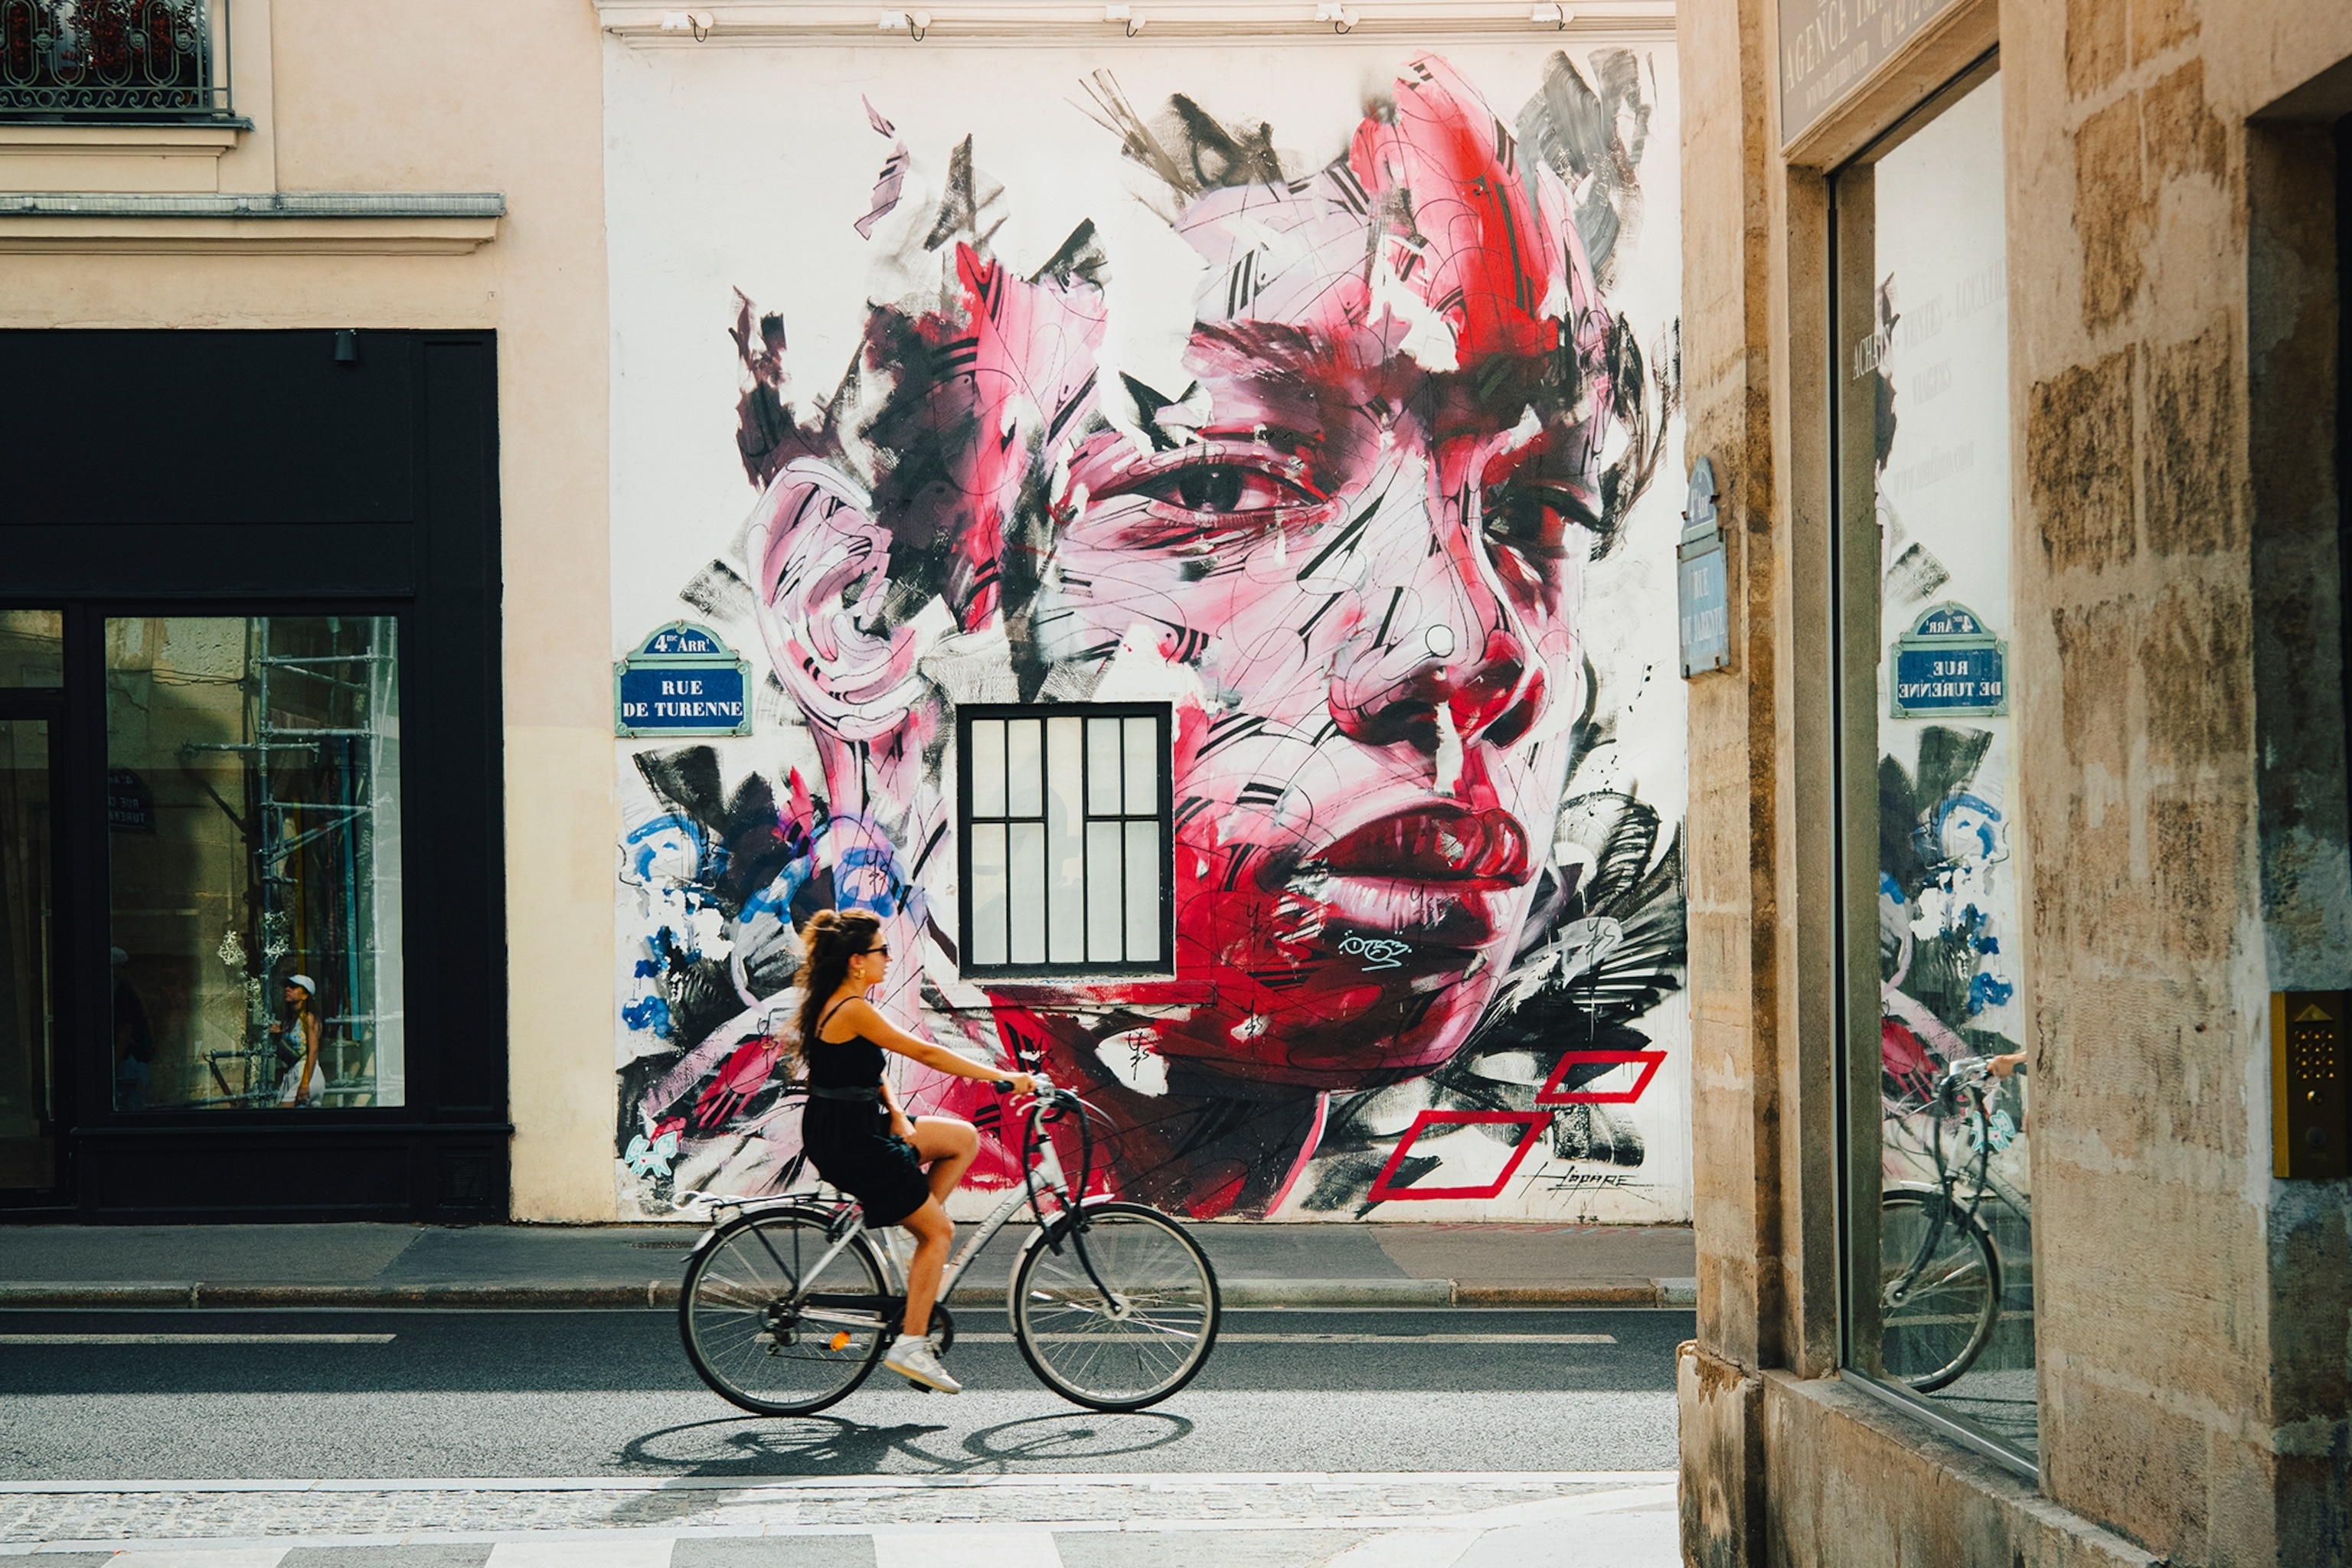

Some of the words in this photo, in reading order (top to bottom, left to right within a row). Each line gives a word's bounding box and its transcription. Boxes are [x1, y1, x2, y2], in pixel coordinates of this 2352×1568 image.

[1786, 0, 1849, 93] AGENCE
[662, 680, 704, 695] RUE
[622, 702, 649, 717] DE
[654, 701, 743, 717] TURENNE
